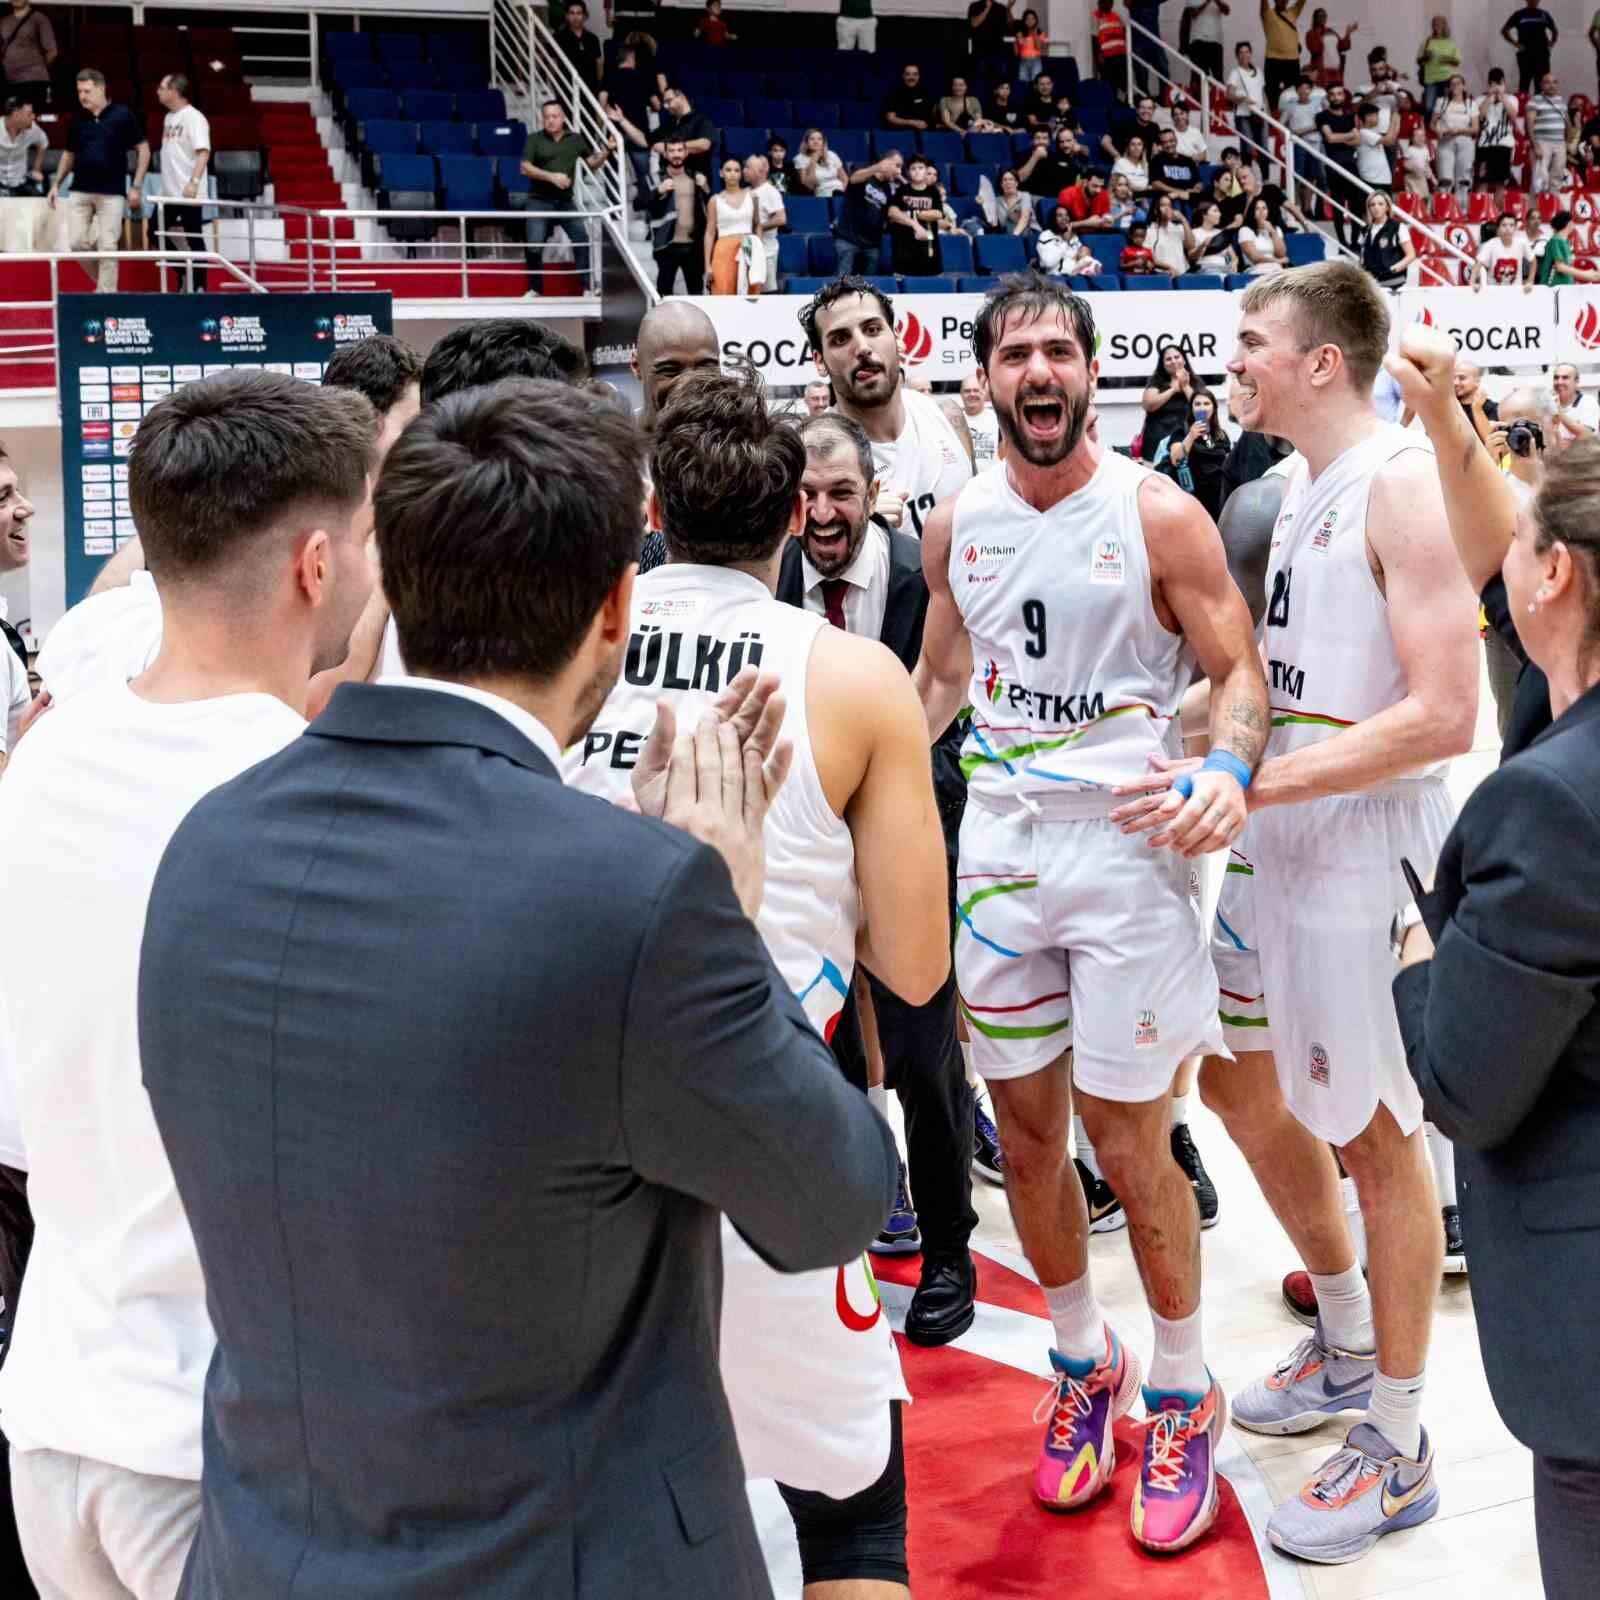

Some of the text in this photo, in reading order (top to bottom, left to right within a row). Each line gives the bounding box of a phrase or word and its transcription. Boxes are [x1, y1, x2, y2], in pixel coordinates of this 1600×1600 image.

[1110, 333, 1217, 360] SOCAR
[1448, 326, 1541, 352] SOCAR
[87, 406, 104, 418] FIAT
[980, 545, 1016, 556] Petkim
[1022, 598, 1048, 660] 9
[624, 624, 764, 693] ÜLKÜ
[580, 730, 649, 769] PE
